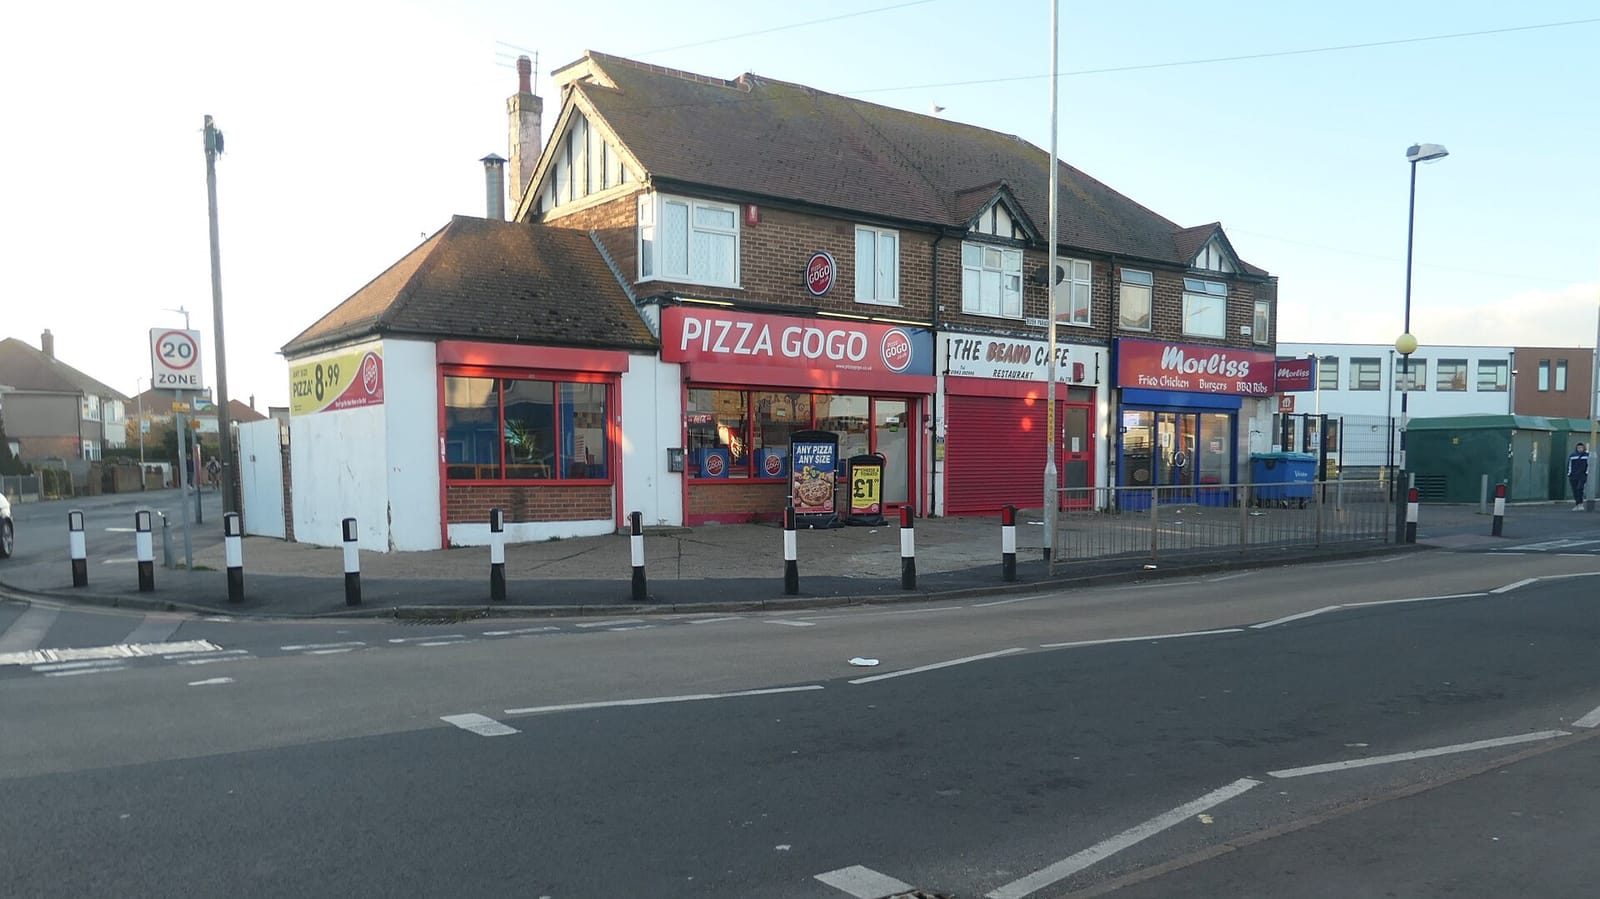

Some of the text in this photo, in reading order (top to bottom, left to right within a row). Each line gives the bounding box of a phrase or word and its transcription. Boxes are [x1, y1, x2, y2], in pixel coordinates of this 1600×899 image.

[809, 265, 829, 284] GOGO
[680, 317, 868, 362] PIZZA GOGO
[162, 342, 191, 358] 20
[885, 343, 907, 358] GOGO
[954, 338, 982, 361] THE
[986, 341, 1032, 365] BEANO
[1161, 346, 1249, 378] Morliss
[159, 374, 197, 385] ZONE
[992, 369, 1034, 379] RESTAURANT
[1277, 367, 1310, 378] Morliss
[315, 364, 340, 401] 8.99
[1138, 374, 1268, 394] Fried Chicken Burgers BBQ Ribs
[796, 446, 833, 454] ANY PIZZA
[798, 455, 831, 464] ANY SIZE
